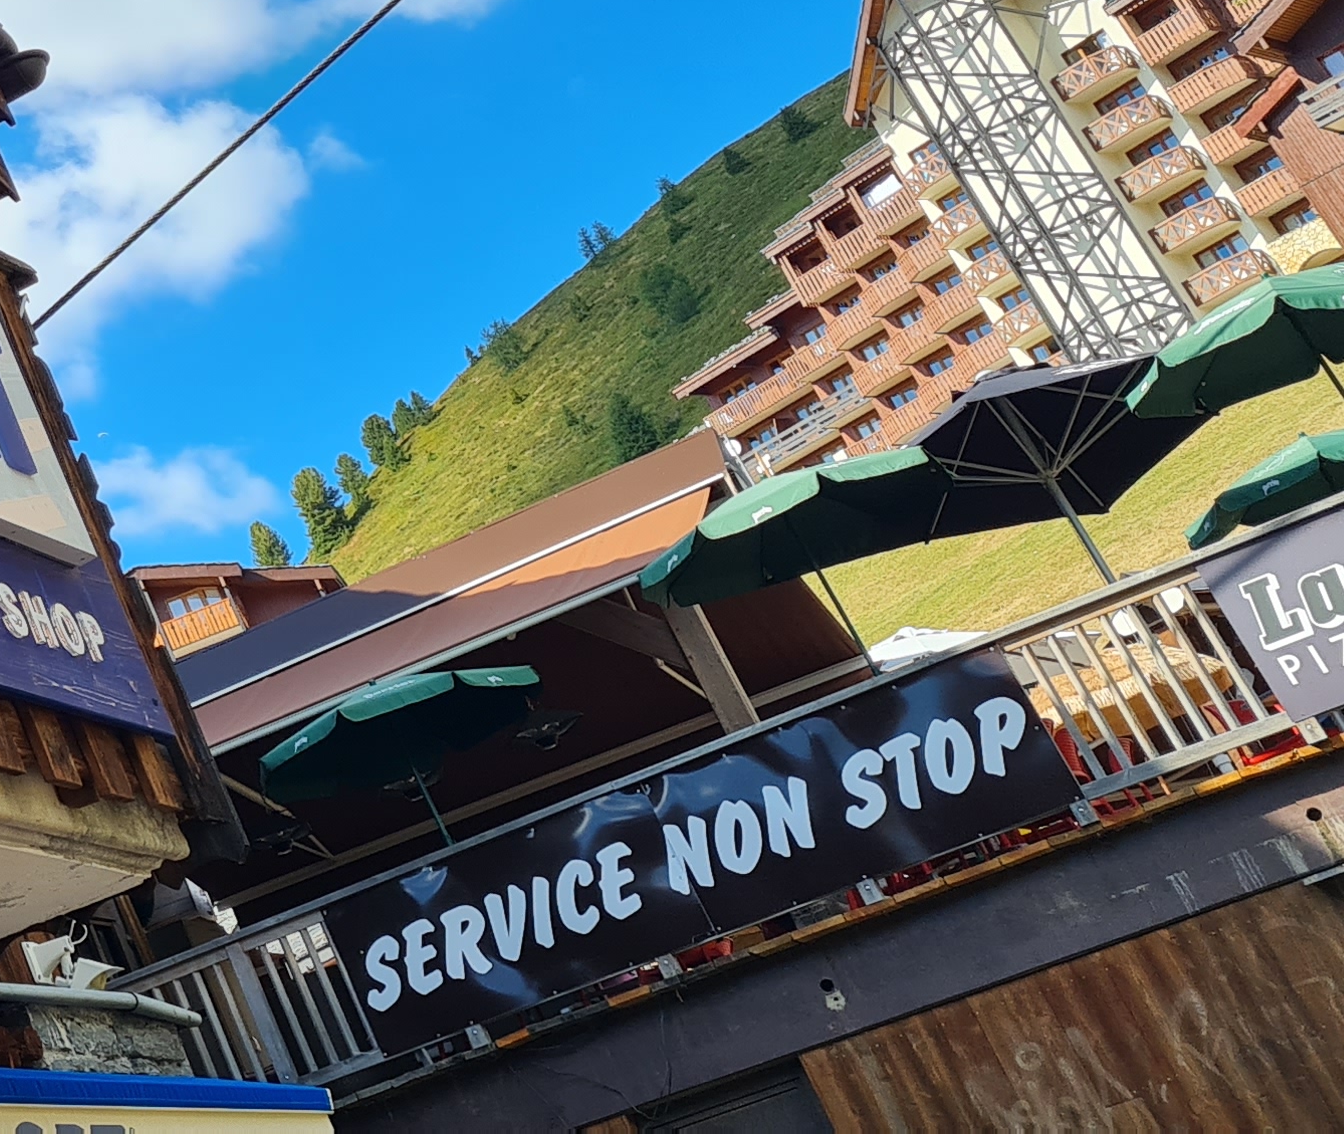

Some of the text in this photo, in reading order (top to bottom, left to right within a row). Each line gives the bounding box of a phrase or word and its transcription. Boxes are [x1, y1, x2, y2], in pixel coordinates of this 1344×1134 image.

[365, 695, 1028, 1013] SERVICE NON STOP
